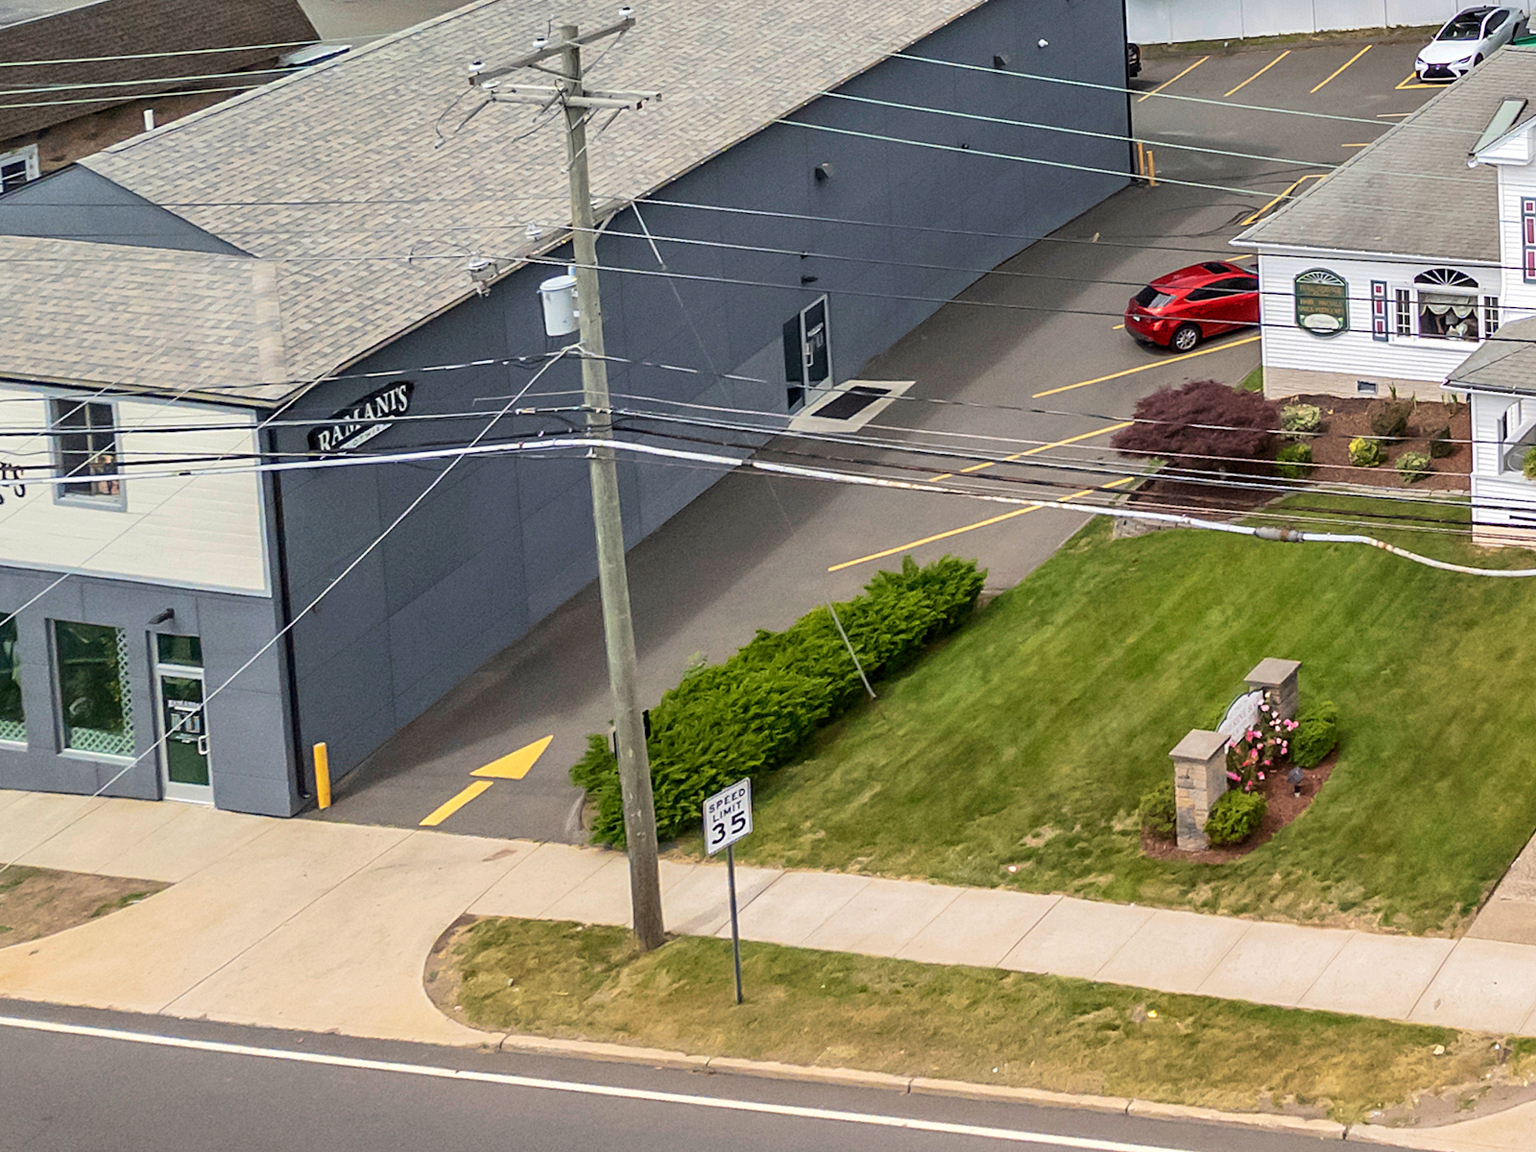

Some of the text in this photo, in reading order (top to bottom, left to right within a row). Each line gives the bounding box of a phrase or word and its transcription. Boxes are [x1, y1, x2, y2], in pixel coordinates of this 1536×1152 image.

[708, 788, 746, 813] SPEED
[713, 800, 742, 823] LIMIT
[712, 810, 746, 844] 35
